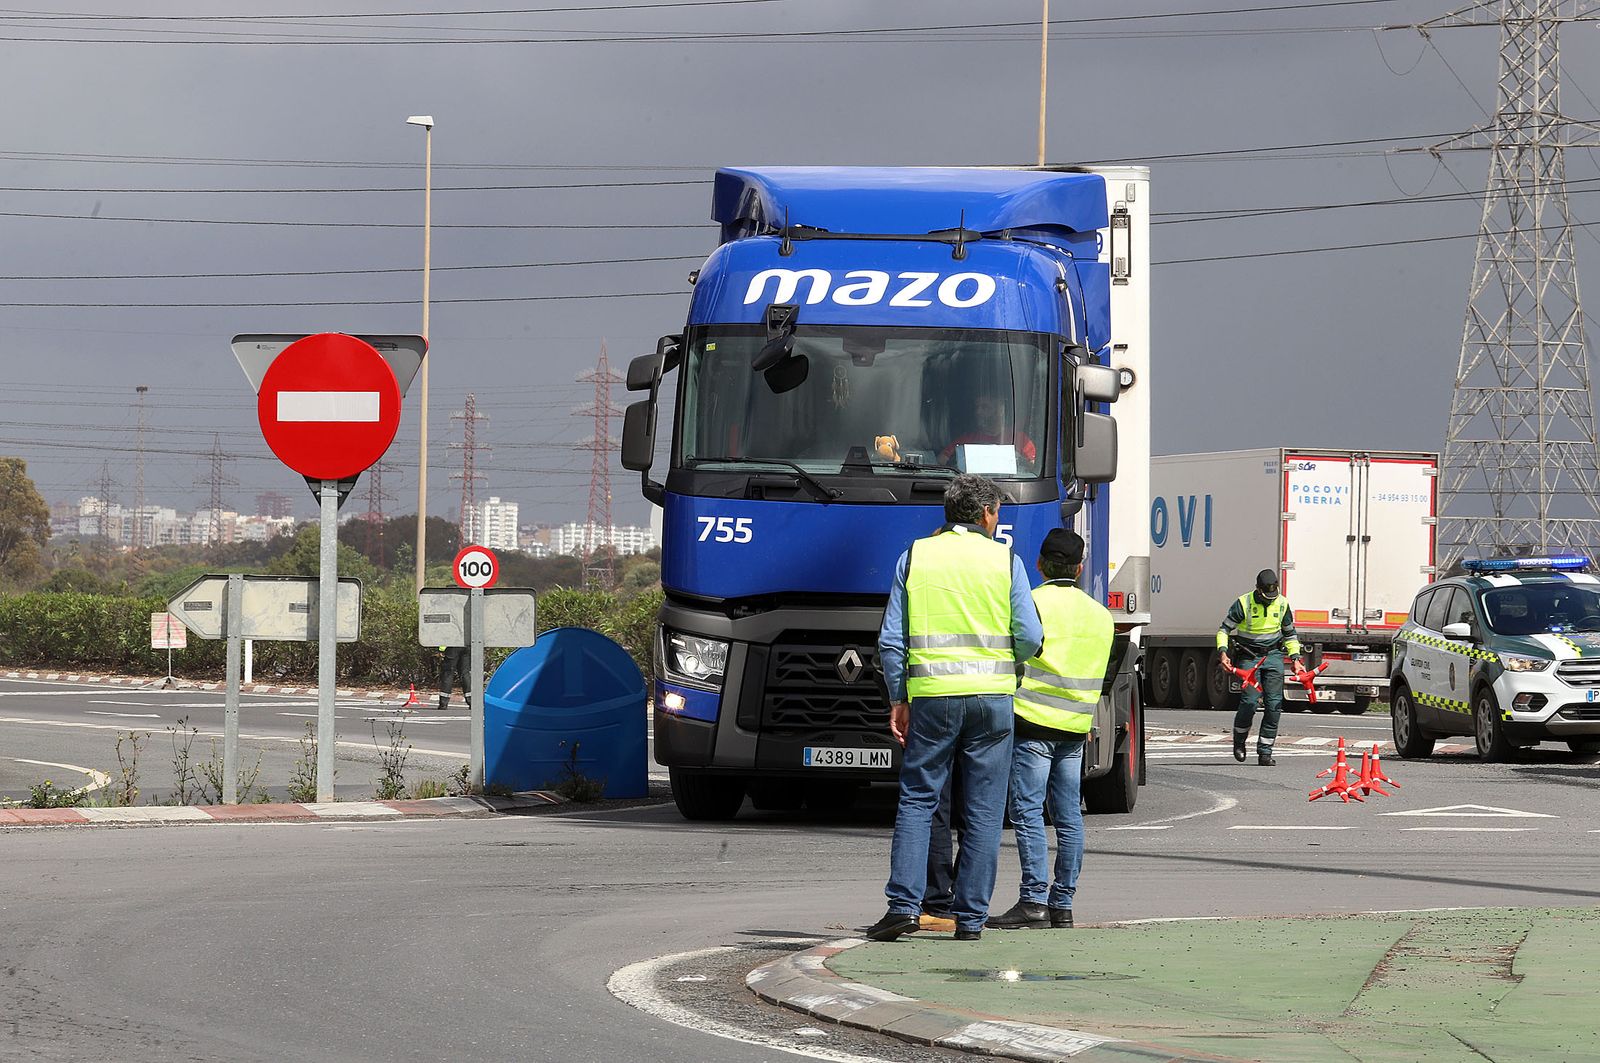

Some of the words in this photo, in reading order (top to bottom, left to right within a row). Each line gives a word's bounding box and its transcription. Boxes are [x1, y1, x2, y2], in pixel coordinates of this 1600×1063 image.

[743, 268, 997, 308] mazo
[1293, 485, 1348, 494] POCOVI
[1299, 496, 1341, 505] IBERIA
[697, 516, 753, 543] 755
[992, 524, 1014, 548] 5
[461, 562, 491, 577] 100
[815, 750, 853, 765] 4389
[860, 751, 889, 766] LMN
